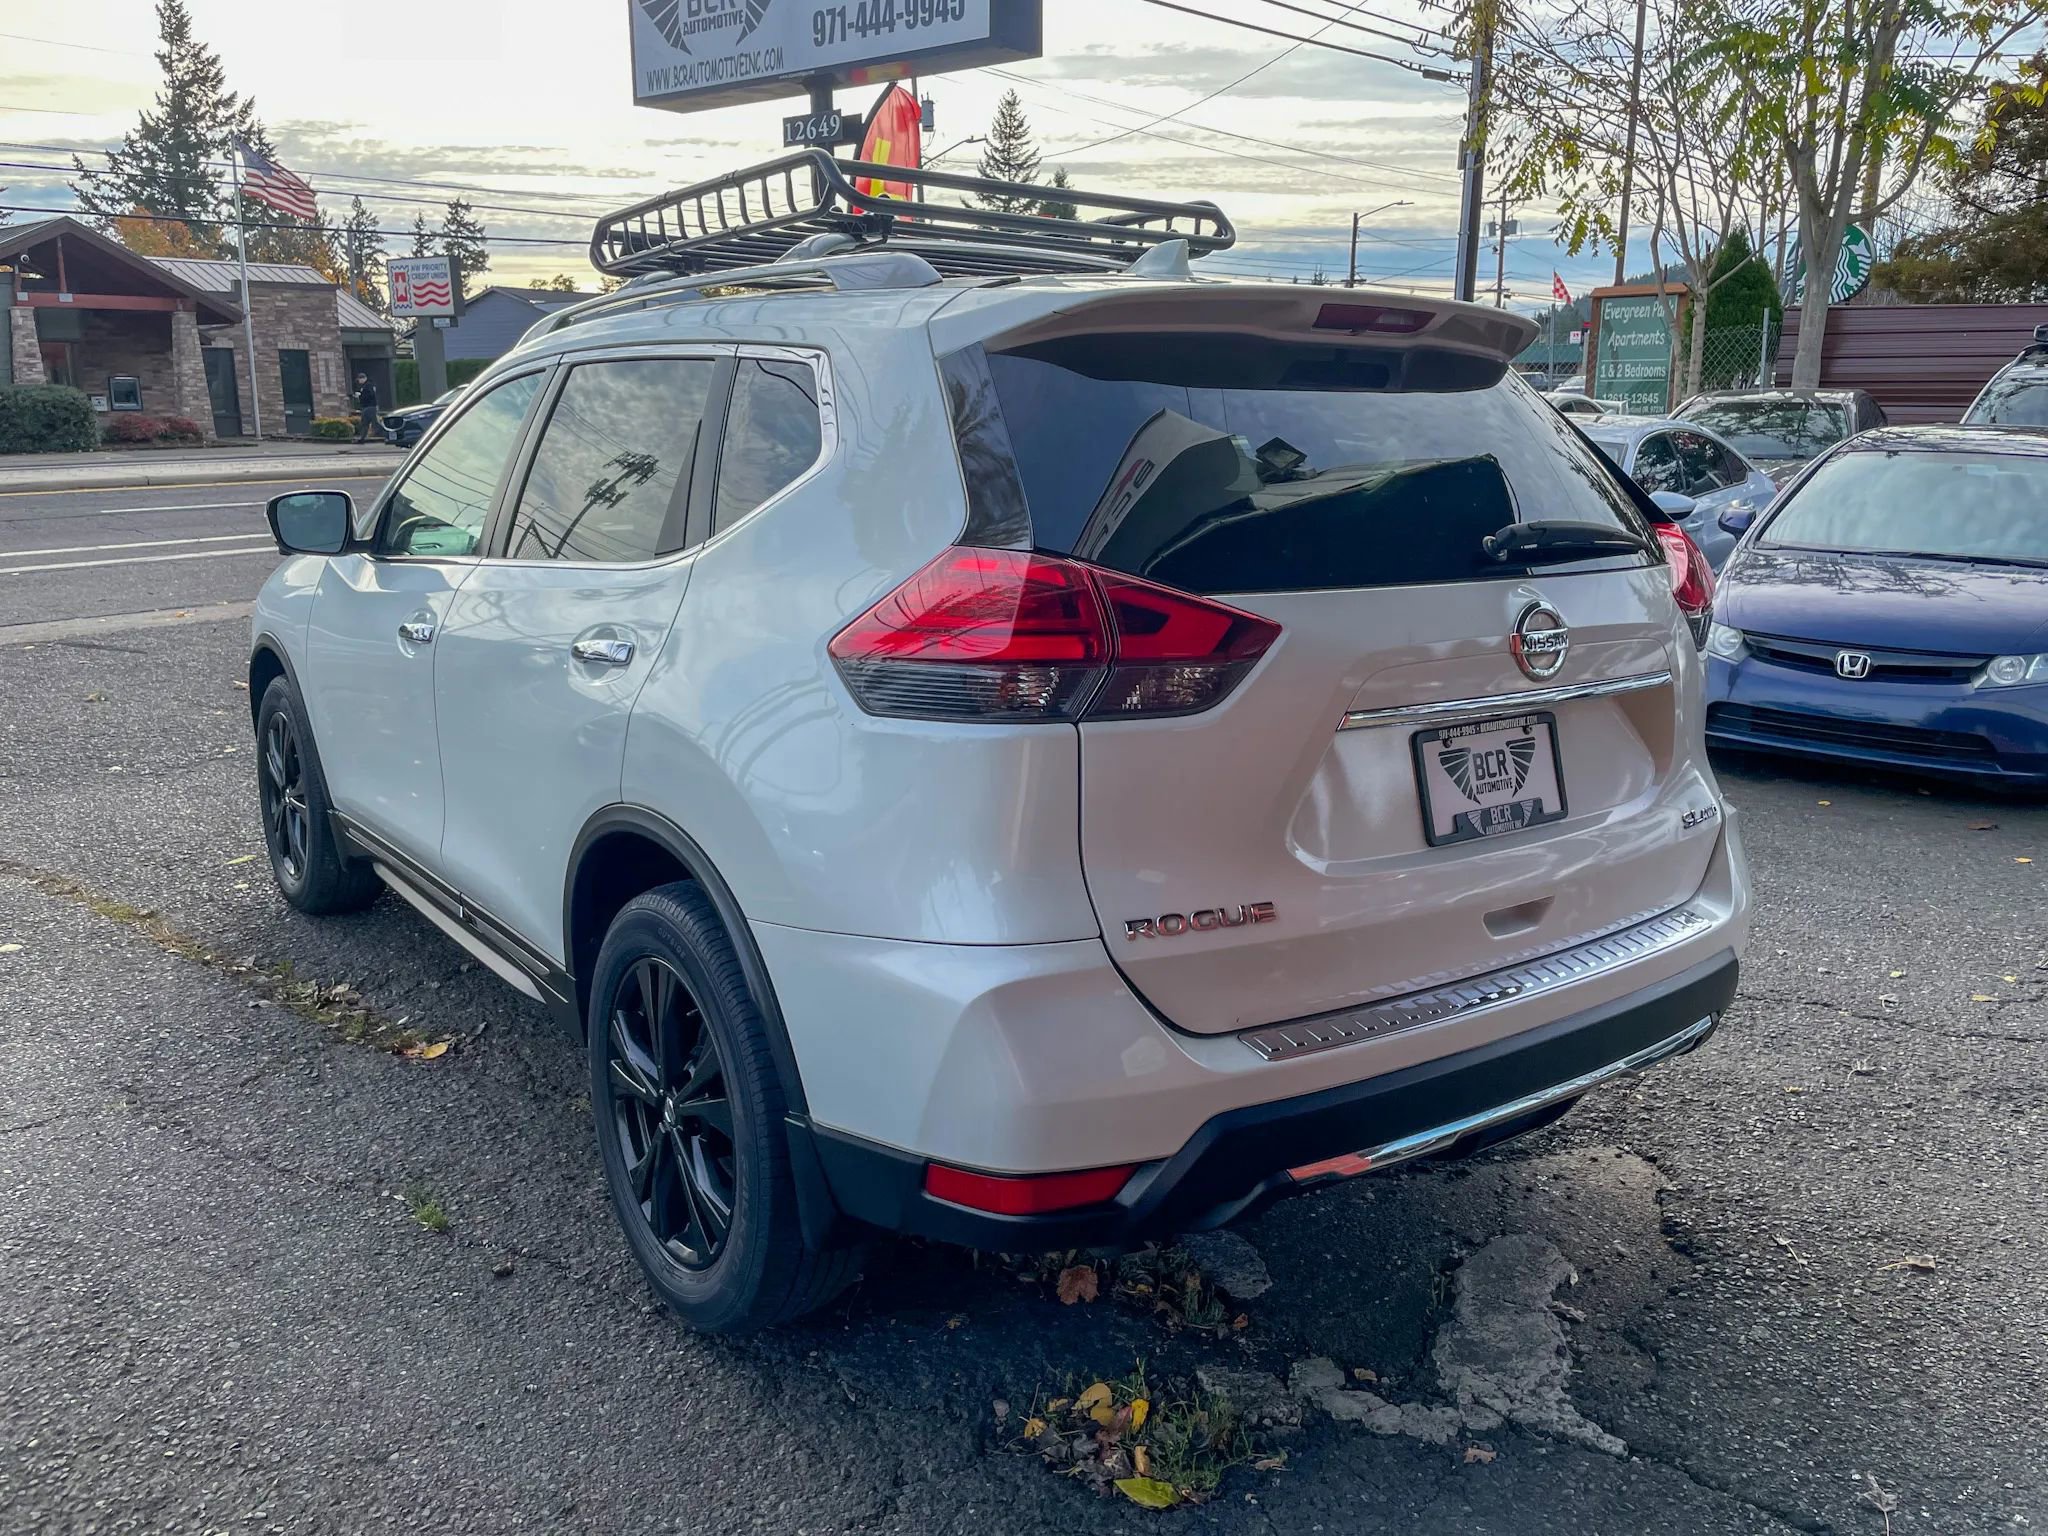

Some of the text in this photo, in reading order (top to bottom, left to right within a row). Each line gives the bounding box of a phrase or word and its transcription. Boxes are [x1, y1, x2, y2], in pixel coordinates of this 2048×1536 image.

[683, 9, 744, 36] AUTOMOTIVE
[813, 0, 965, 47] 971-444-9945
[646, 47, 784, 92] WWW.BCRAUTOMOTIVEINC.COM
[784, 114, 840, 142] 12649
[422, 262, 447, 271] PRIORITY
[1604, 299, 1674, 323] Evergreen Pa
[1608, 330, 1666, 351] Apartments
[1600, 363, 1667, 378] 1 & 2 Bedrooms
[1521, 633, 1568, 650] NISSAN
[1438, 725, 1476, 740] 971-444-9945
[1472, 749, 1509, 781] BCR
[1476, 777, 1513, 795] AUTOMOTIVE
[1490, 804, 1512, 825] BCR
[1486, 820, 1514, 835] AUTOMOTIVE
[1123, 900, 1278, 942] ROGUE
